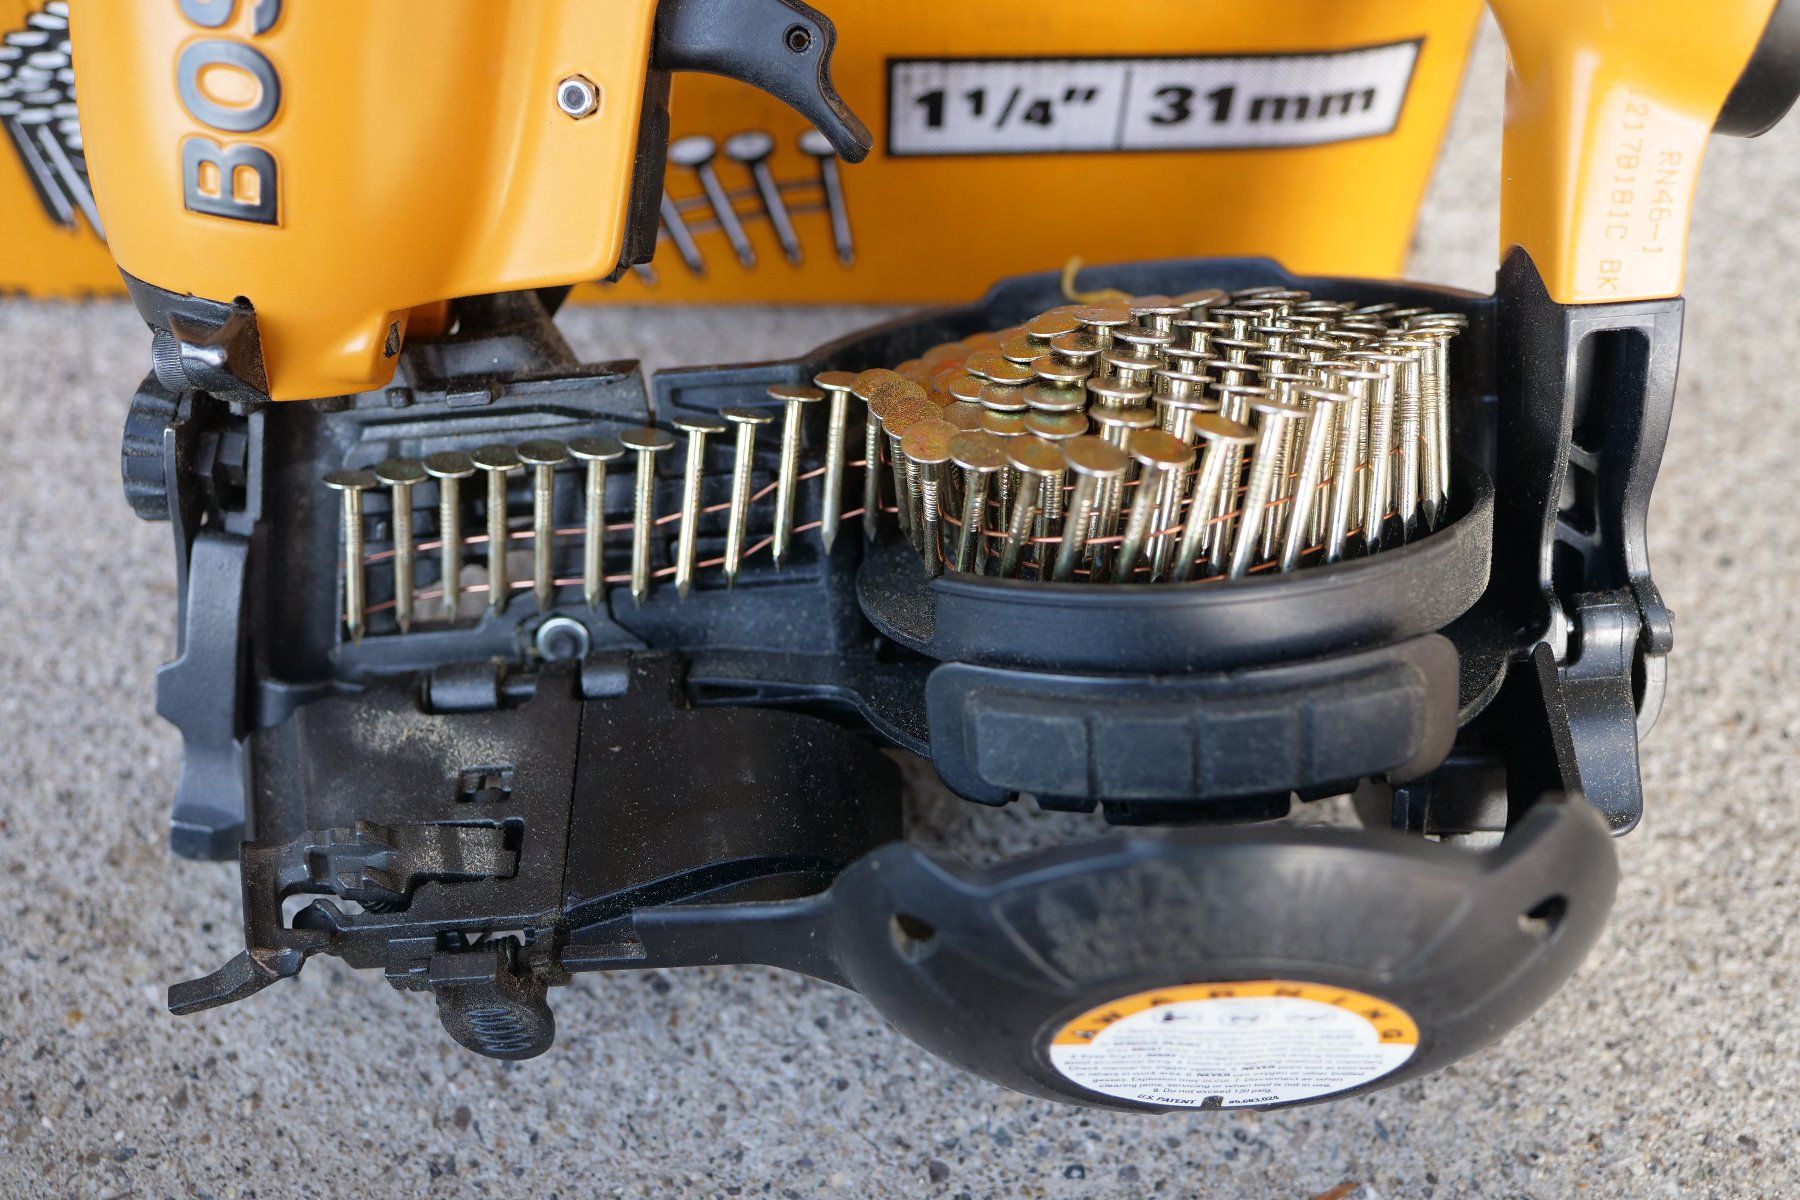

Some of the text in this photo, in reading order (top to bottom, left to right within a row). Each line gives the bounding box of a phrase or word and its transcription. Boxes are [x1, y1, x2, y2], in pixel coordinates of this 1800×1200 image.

[1149, 83, 1376, 125] 31mm
[1643, 150, 1682, 253] RN46-1
[1597, 259, 1623, 291] BK
